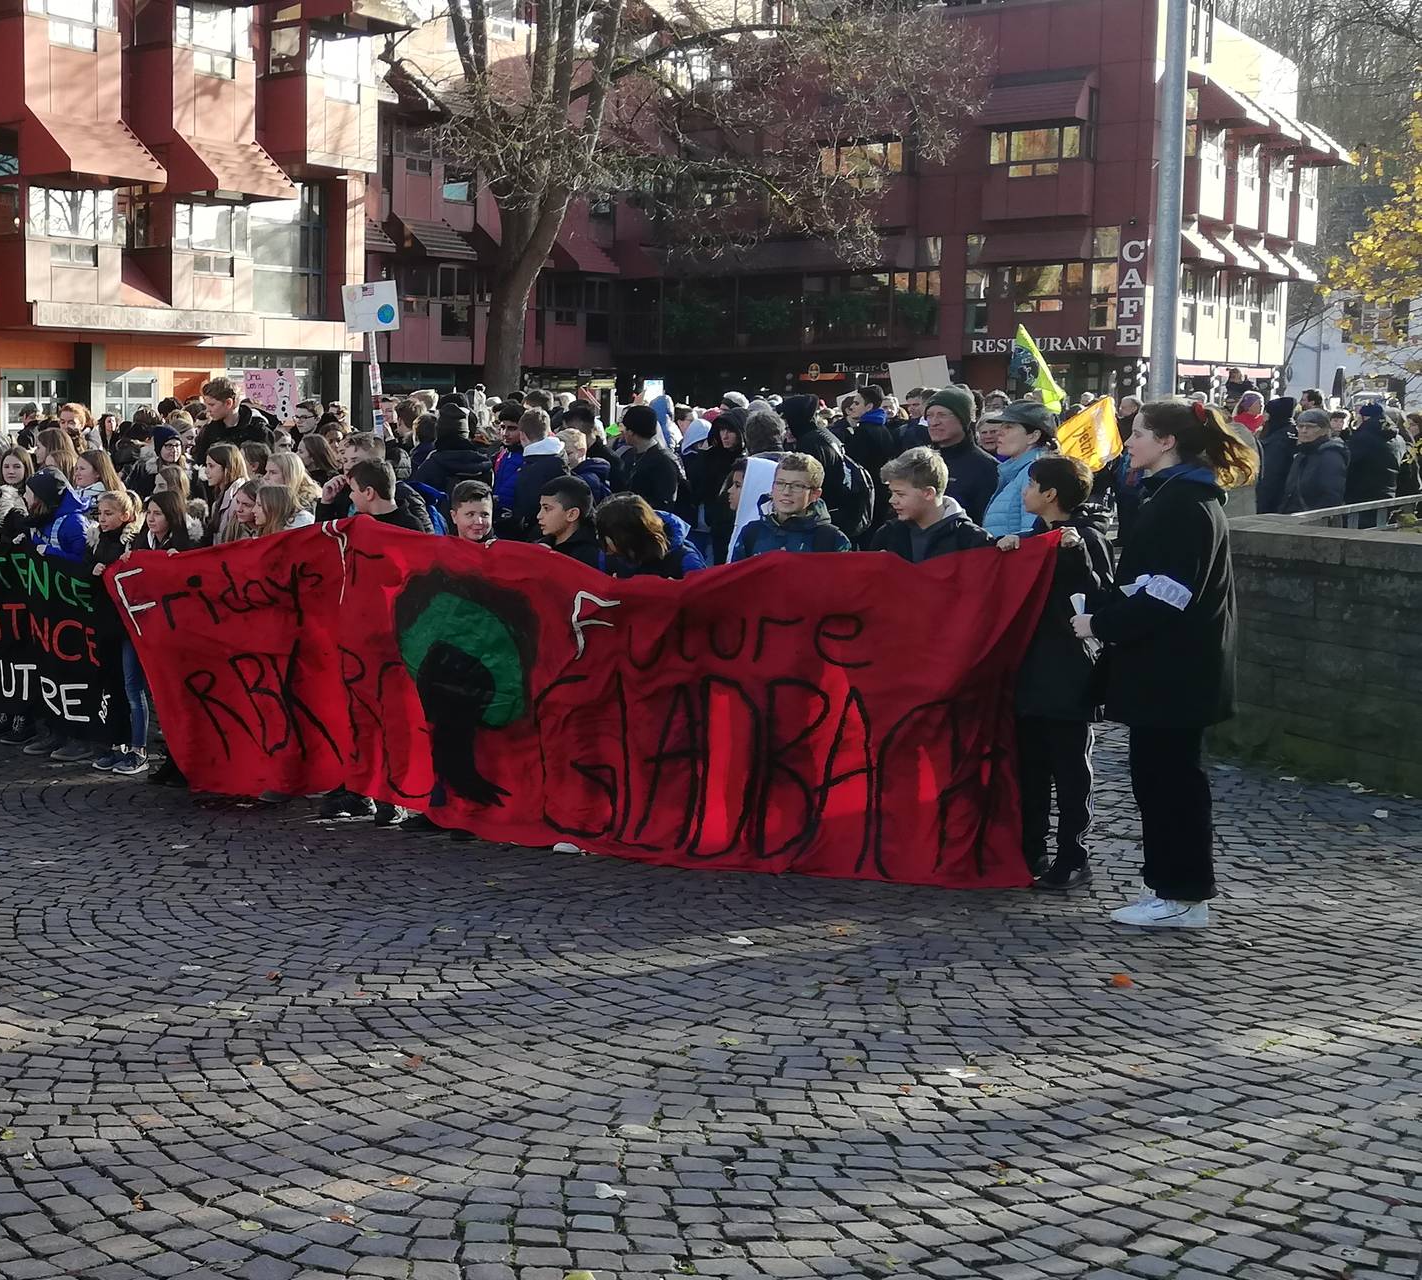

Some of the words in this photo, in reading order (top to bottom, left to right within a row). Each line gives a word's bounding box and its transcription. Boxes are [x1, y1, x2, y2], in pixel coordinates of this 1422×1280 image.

[1116, 240, 1147, 346] CAFE
[971, 336, 1106, 354] RESTURANT
[112, 560, 323, 637] Fridays
[183, 638, 344, 766] RBK
